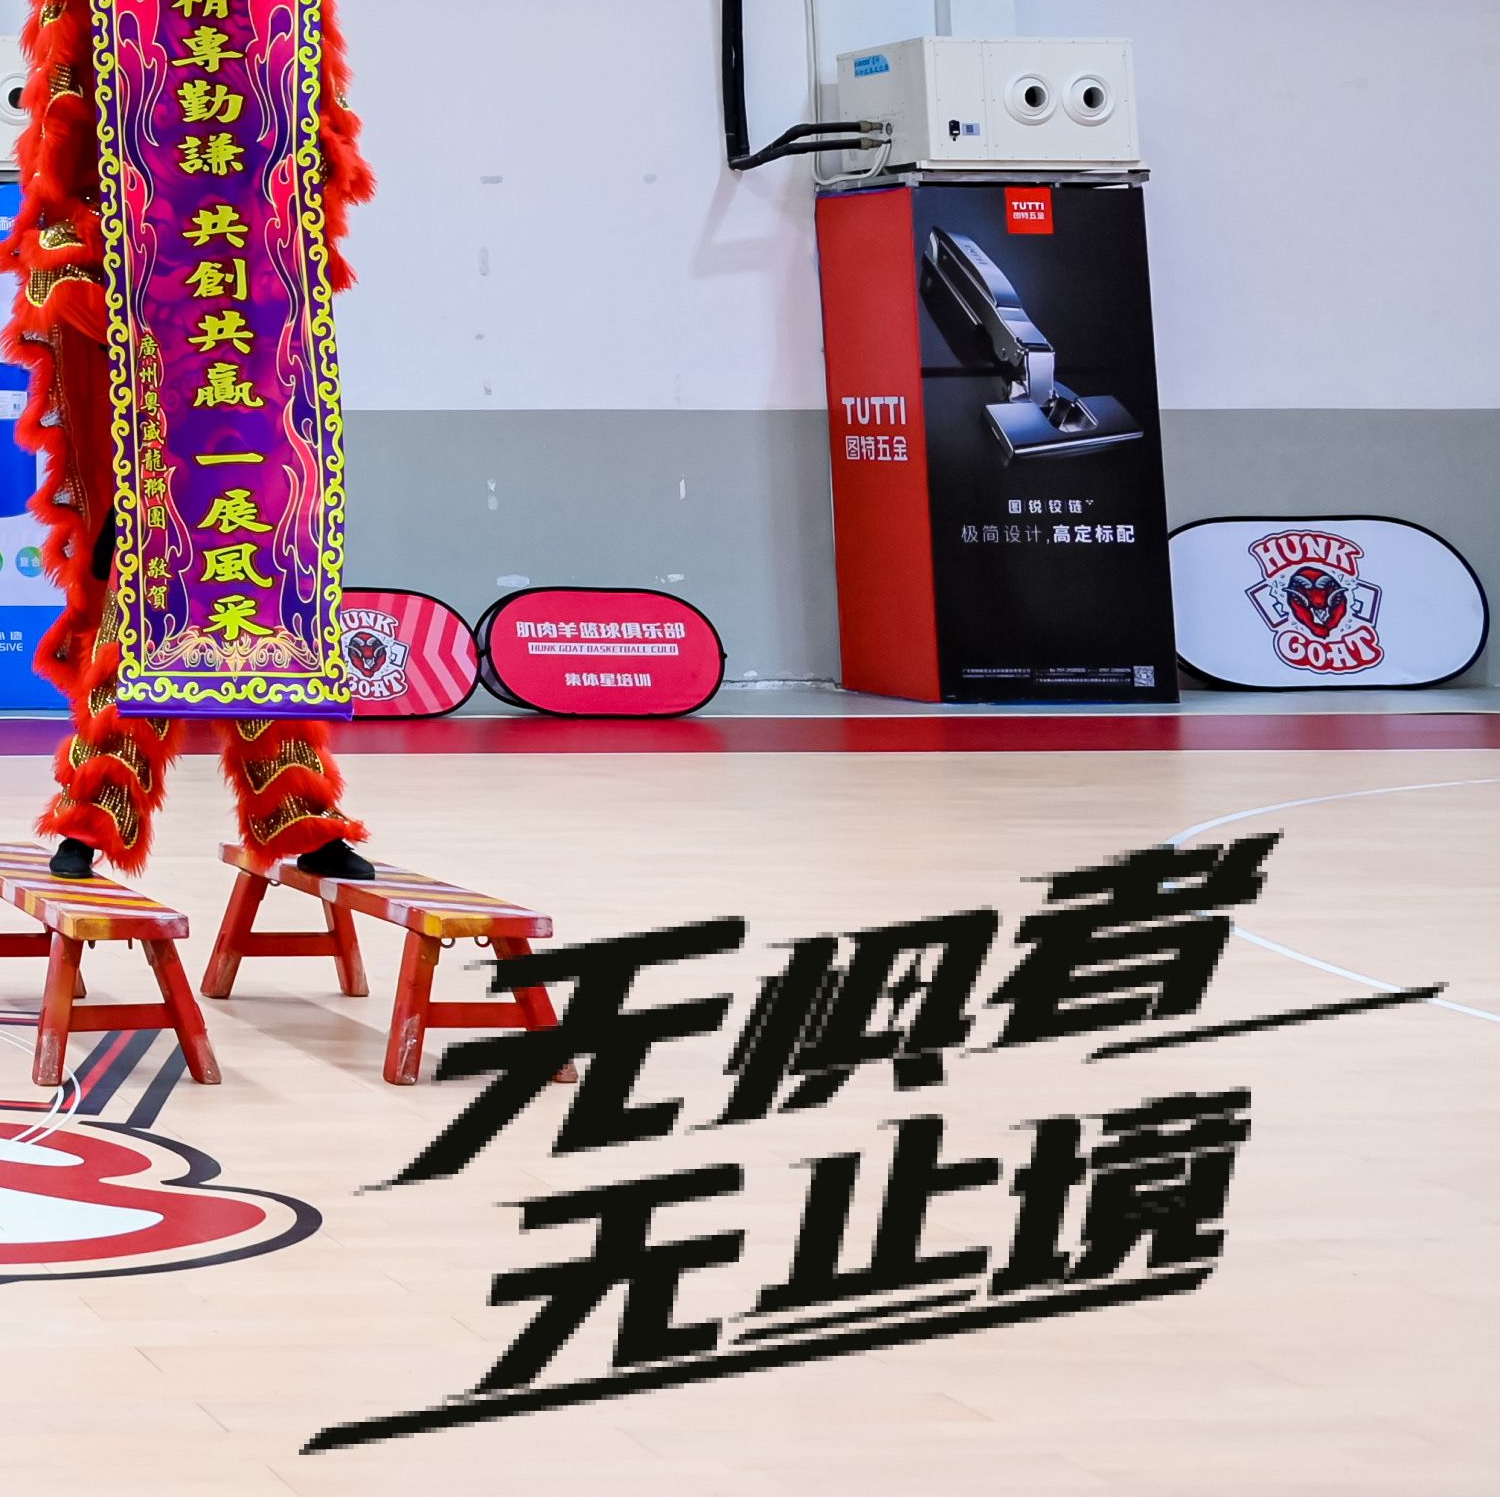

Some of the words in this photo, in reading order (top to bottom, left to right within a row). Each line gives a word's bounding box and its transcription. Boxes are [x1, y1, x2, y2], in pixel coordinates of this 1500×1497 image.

[1012, 201, 1045, 211] TUTTI
[841, 396, 906, 425] TUTTI
[845, 436, 909, 461] 图特五金
[1253, 535, 1358, 574] HUNK
[516, 621, 686, 640] 肌肉羊篮球俱乐部
[531, 645, 556, 653] HUNK
[558, 645, 583, 653] GOAT
[586, 645, 647, 654] BASKETBALL
[1277, 628, 1379, 667] GOAT
